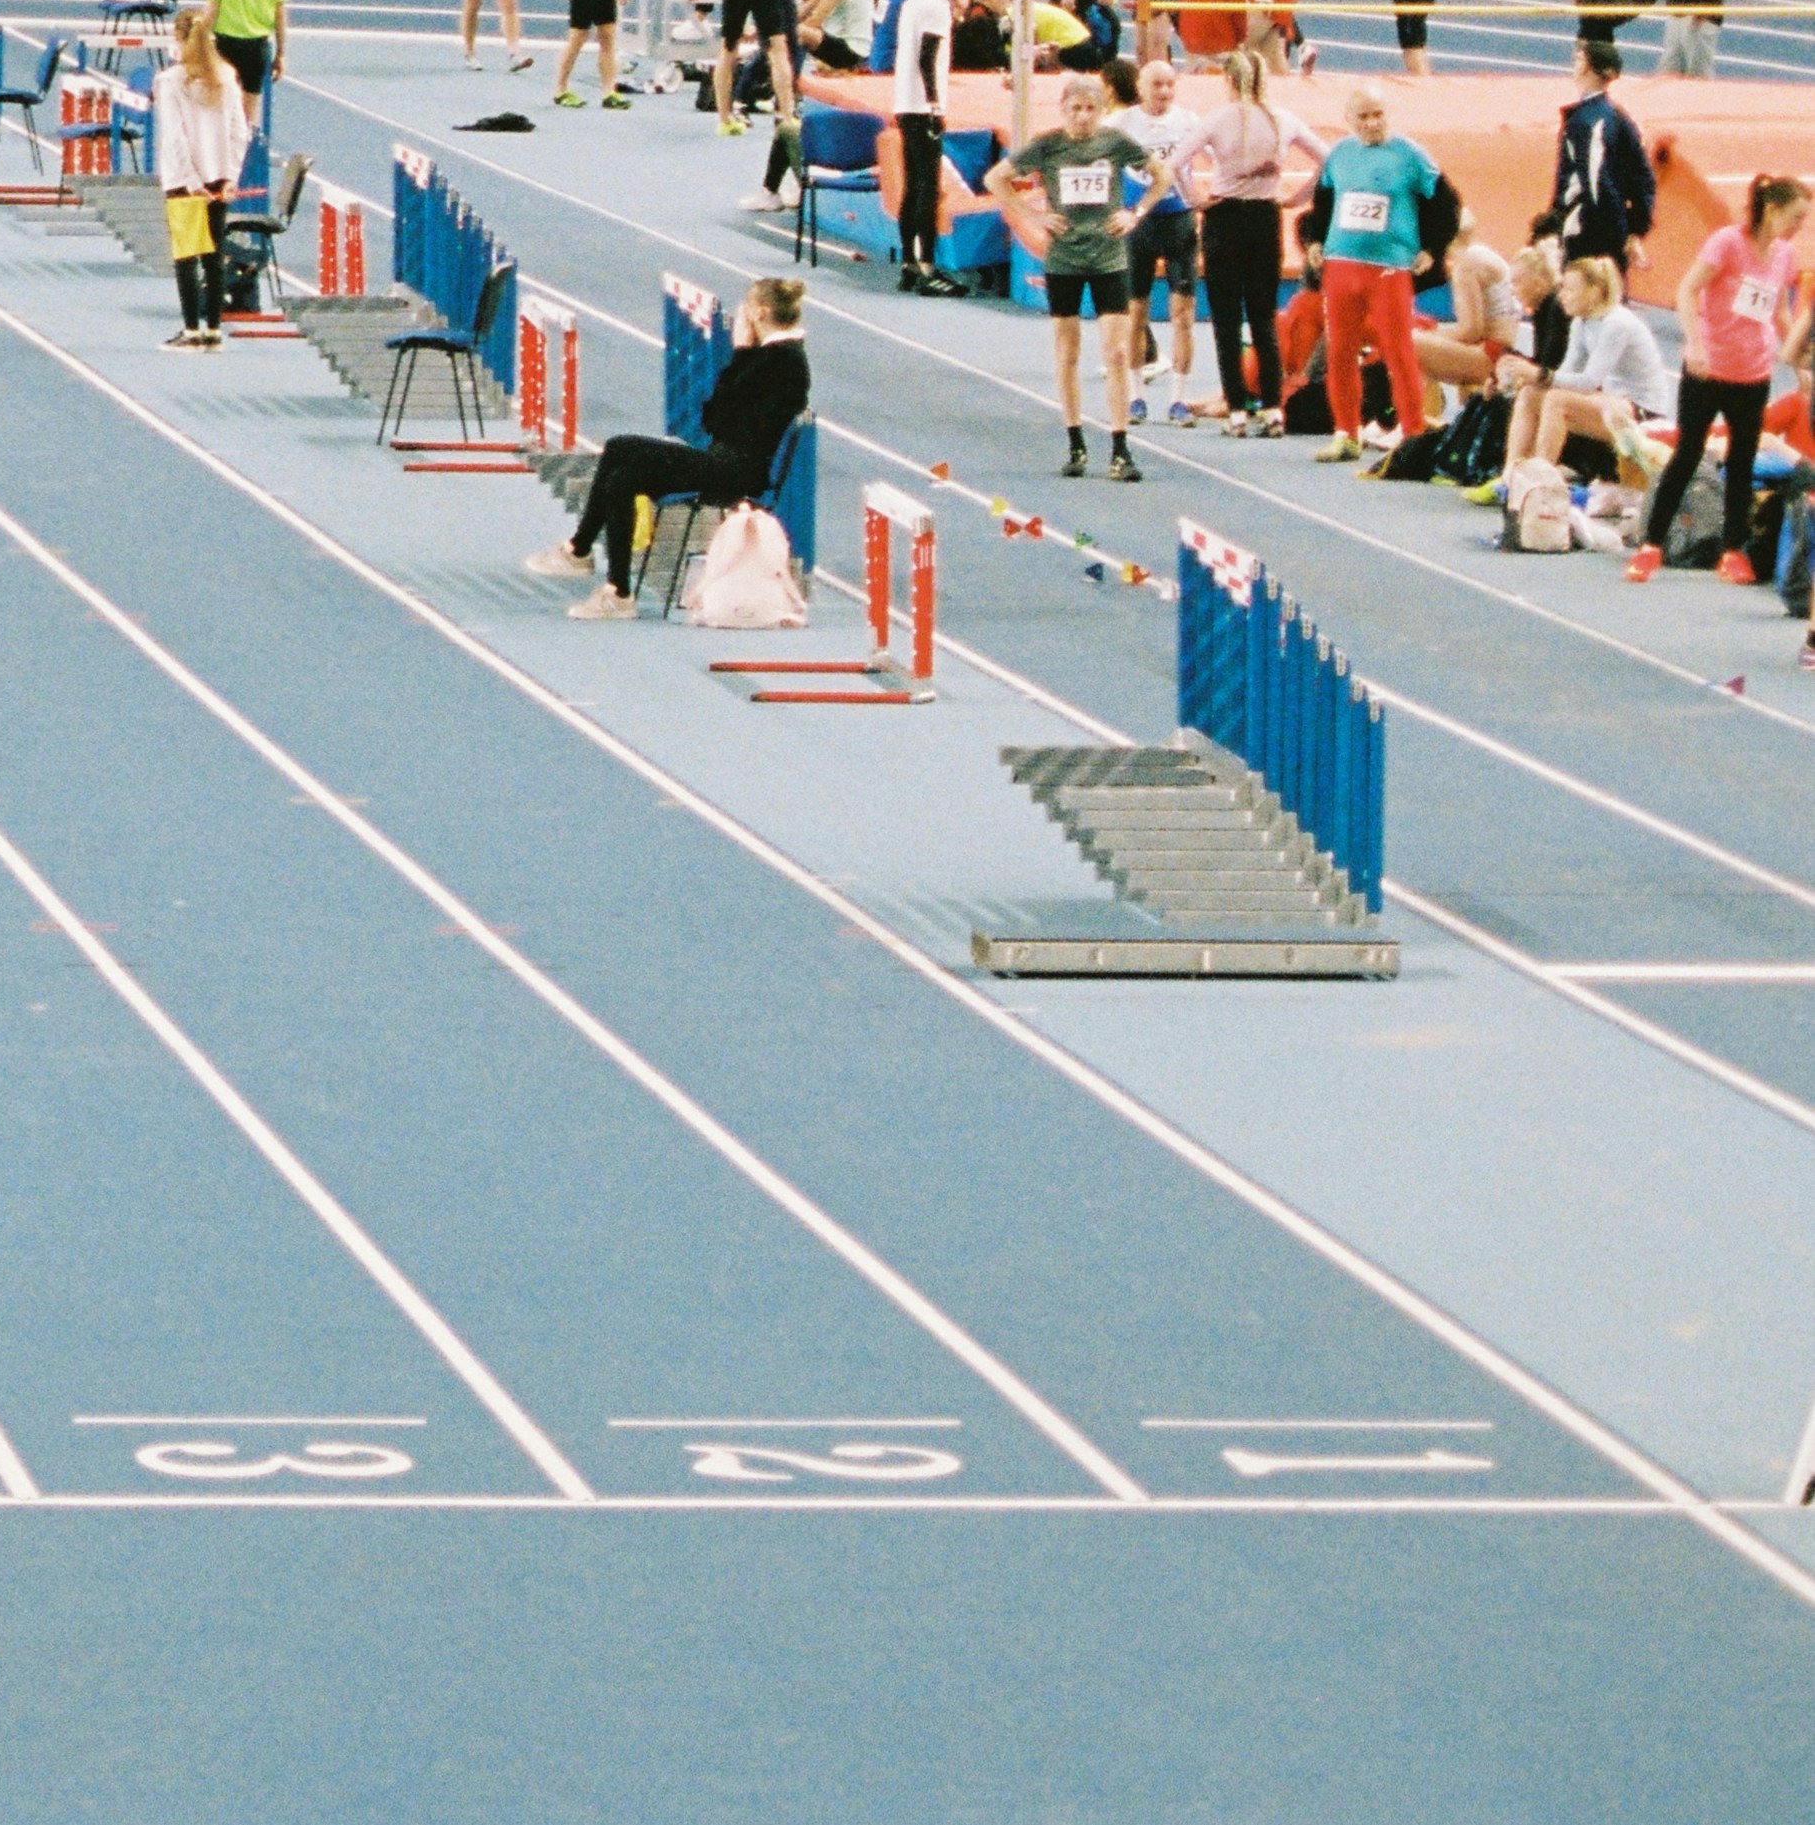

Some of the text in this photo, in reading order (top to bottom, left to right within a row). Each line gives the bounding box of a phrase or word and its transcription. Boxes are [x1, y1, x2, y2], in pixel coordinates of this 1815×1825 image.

[1071, 177, 1105, 193] 175
[1348, 203, 1384, 221] 222
[135, 1441, 413, 1479] 3
[684, 1442, 963, 1482] 2
[1222, 1447, 1495, 1476] 1
